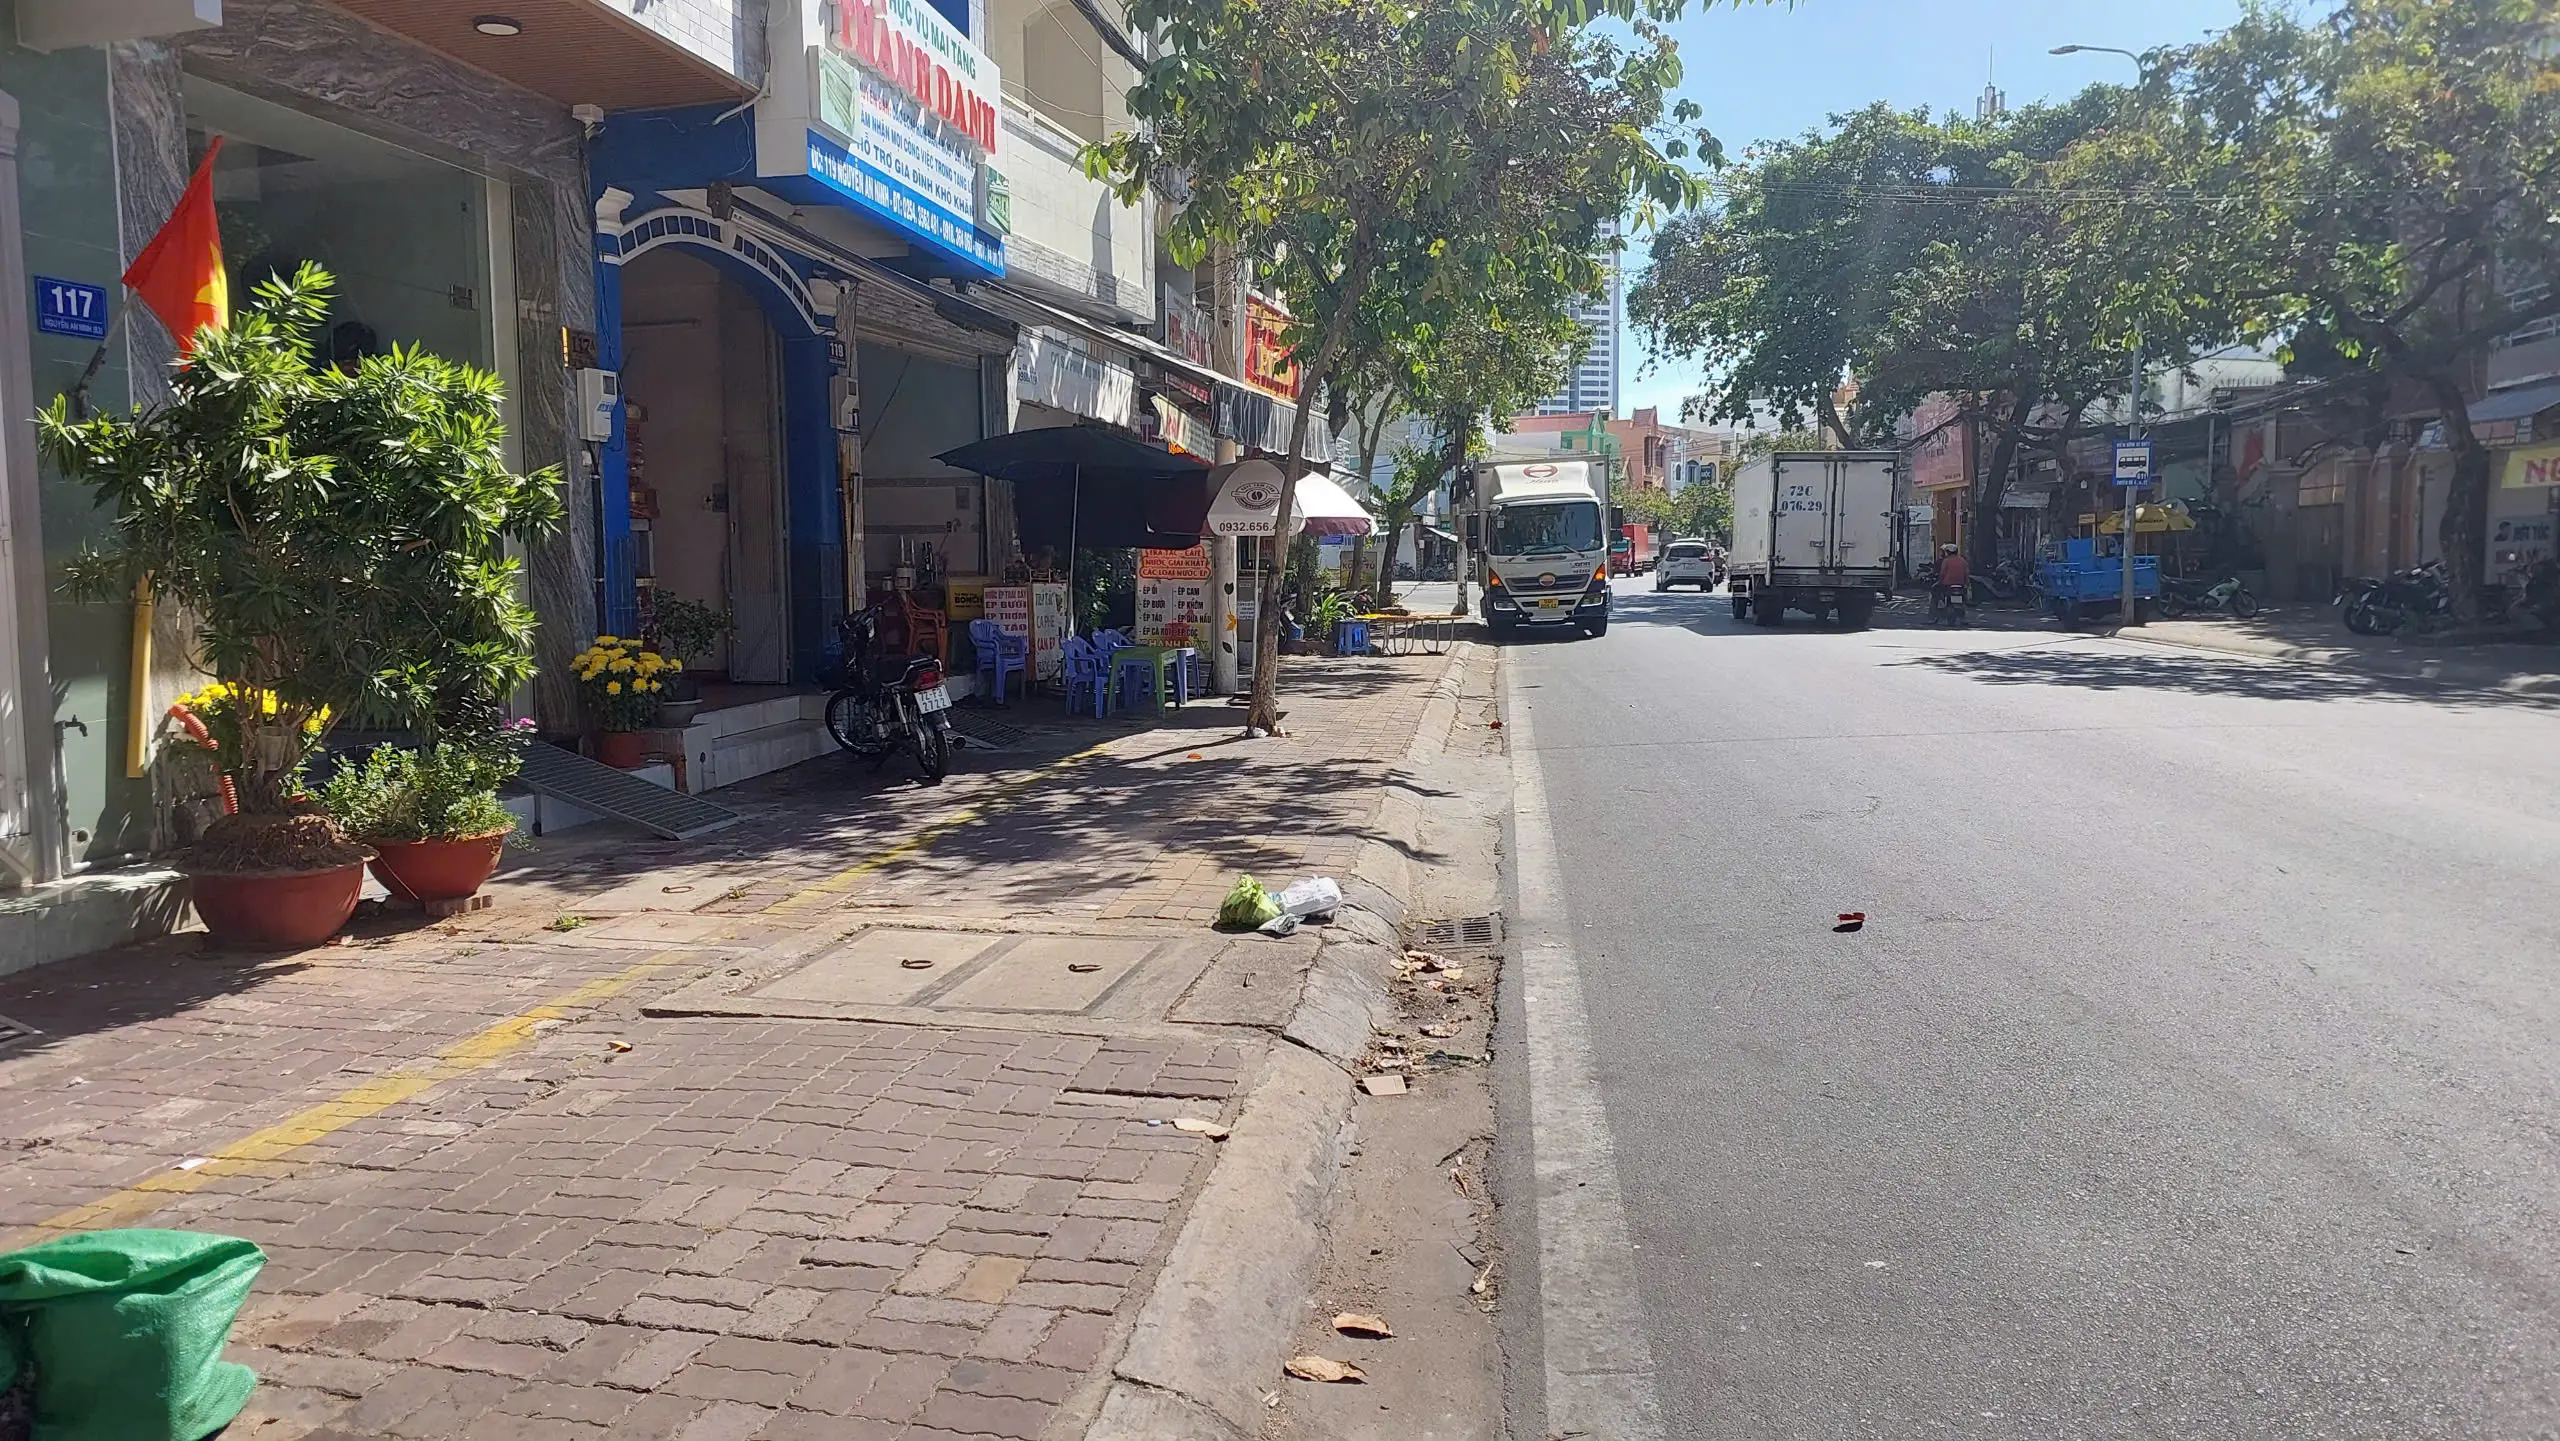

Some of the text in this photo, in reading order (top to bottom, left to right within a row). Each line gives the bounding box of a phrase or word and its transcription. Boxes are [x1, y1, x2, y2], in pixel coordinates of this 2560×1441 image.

[914, 8, 929, 47] VỤ
[931, 22, 949, 58] MAI
[951, 41, 976, 80] TÁNG
[840, 0, 933, 107] THANH
[936, 64, 997, 155] DANH
[872, 116, 890, 142] NHẬN
[890, 127, 903, 152] MỌI
[920, 147, 935, 171] VIỆC
[934, 157, 953, 182] TRONG
[824, 151, 838, 181] 119
[865, 173, 874, 201] AN
[873, 144, 893, 174] TRỢ
[894, 158, 911, 180] GIA
[912, 166, 933, 194] ĐÌNH
[935, 185, 952, 205] KHÓ
[51, 286, 93, 318] 117
[829, 342, 844, 357] 119
[1781, 500, 1823, 512] 076.29
[1789, 485, 1814, 497] 72C
[1186, 587, 1200, 596] CAM
